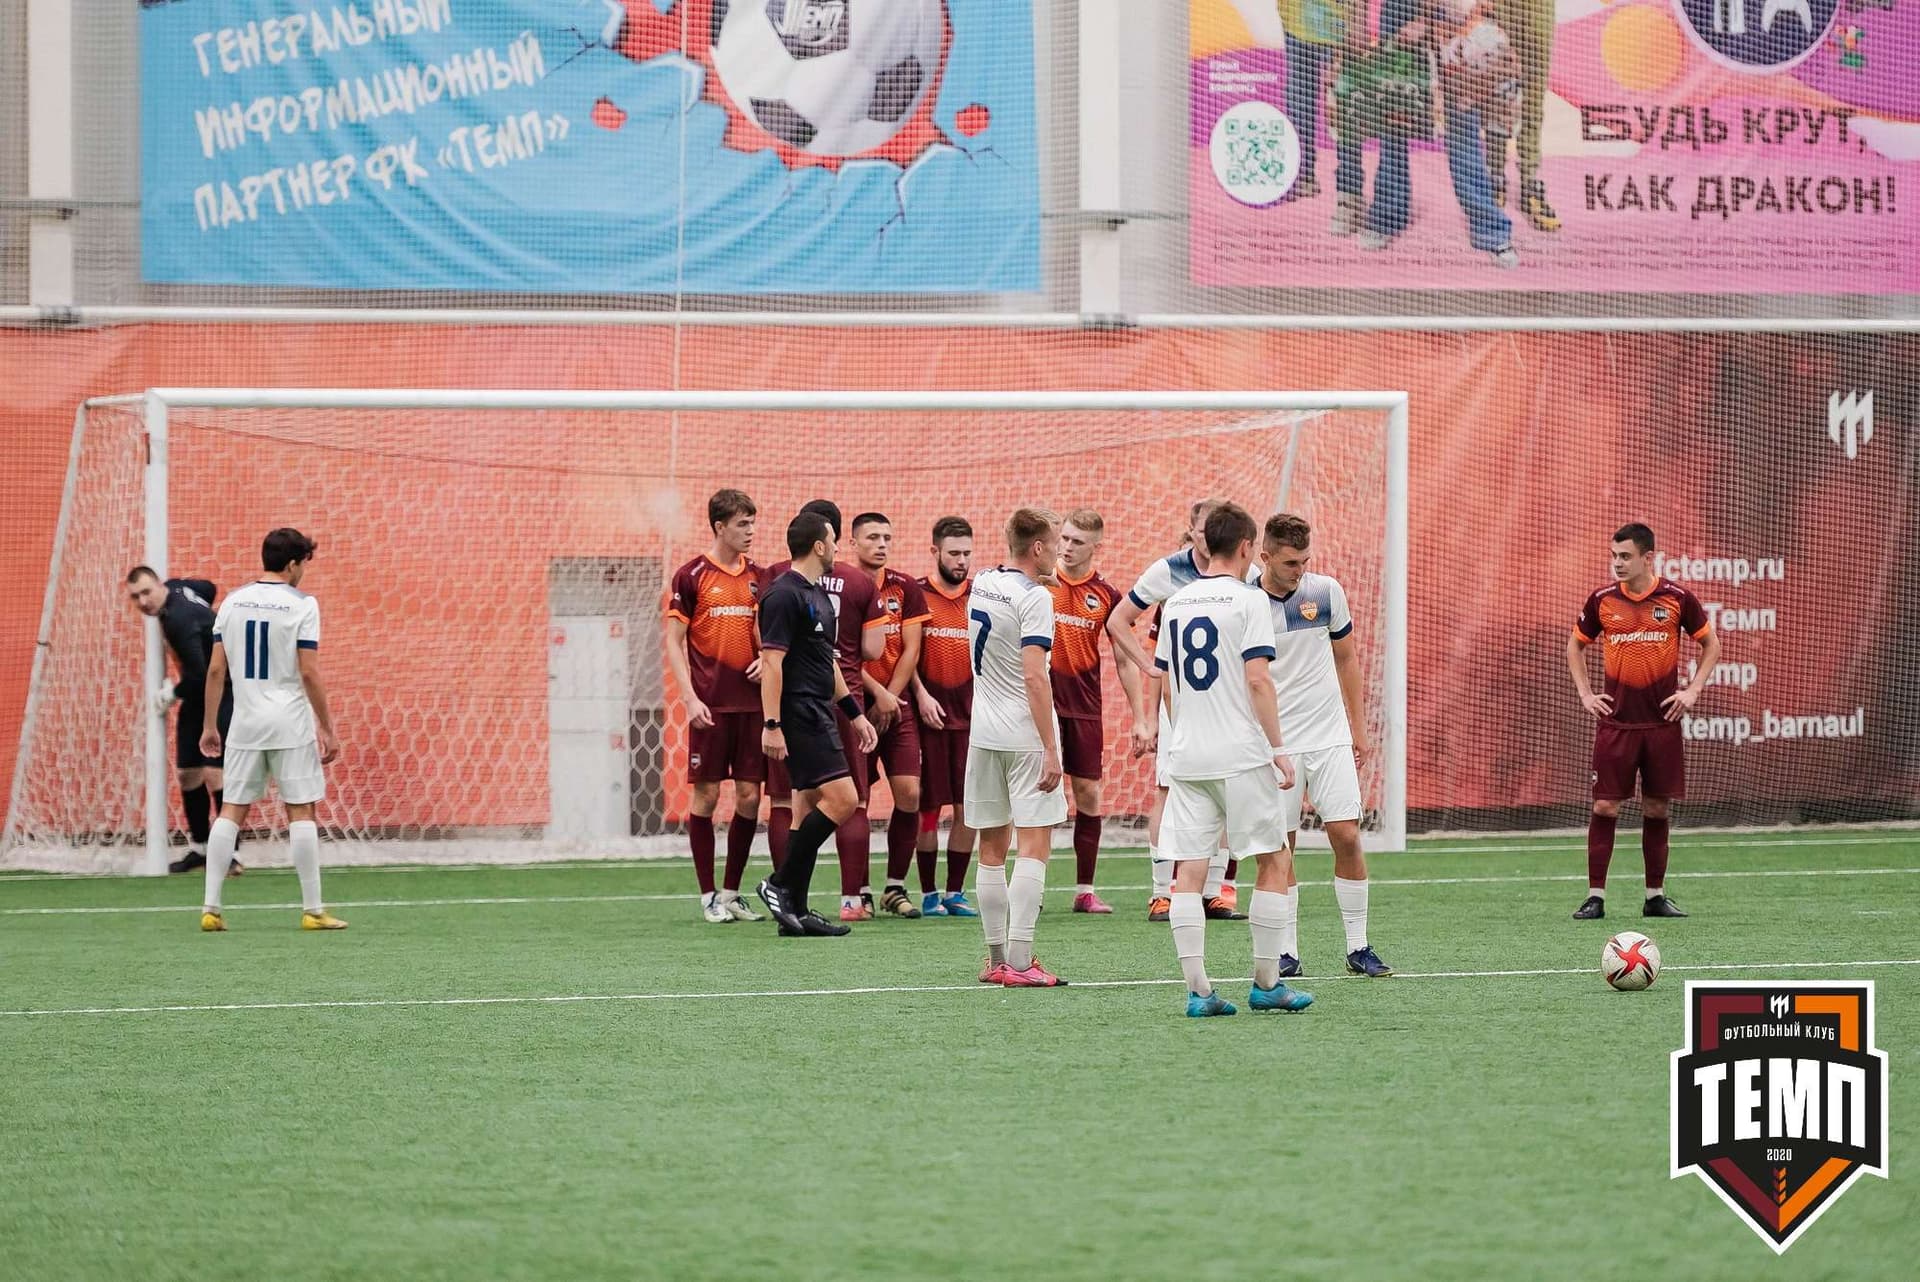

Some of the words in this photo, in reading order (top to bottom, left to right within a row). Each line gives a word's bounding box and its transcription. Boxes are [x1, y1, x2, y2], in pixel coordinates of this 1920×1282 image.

[192, 0, 452, 76] ГЕНЕРАЛЬНЫЙ
[195, 31, 545, 158] ИНФОРМАЦИОННЫЙ
[1580, 104, 1729, 151] БУДЬ
[1742, 106, 1868, 153] КРУТ,
[193, 154, 357, 231] ПАРТНЕР
[365, 137, 429, 190] ФК
[437, 111, 571, 172] «ТЕМП»
[1584, 174, 1678, 212] КАК
[1691, 175, 1896, 220] ДРАКОН!
[1653, 551, 1785, 588] fctemp.ru
[244, 619, 270, 680] 11
[970, 607, 992, 677] 7
[1169, 615, 1220, 695] 18
